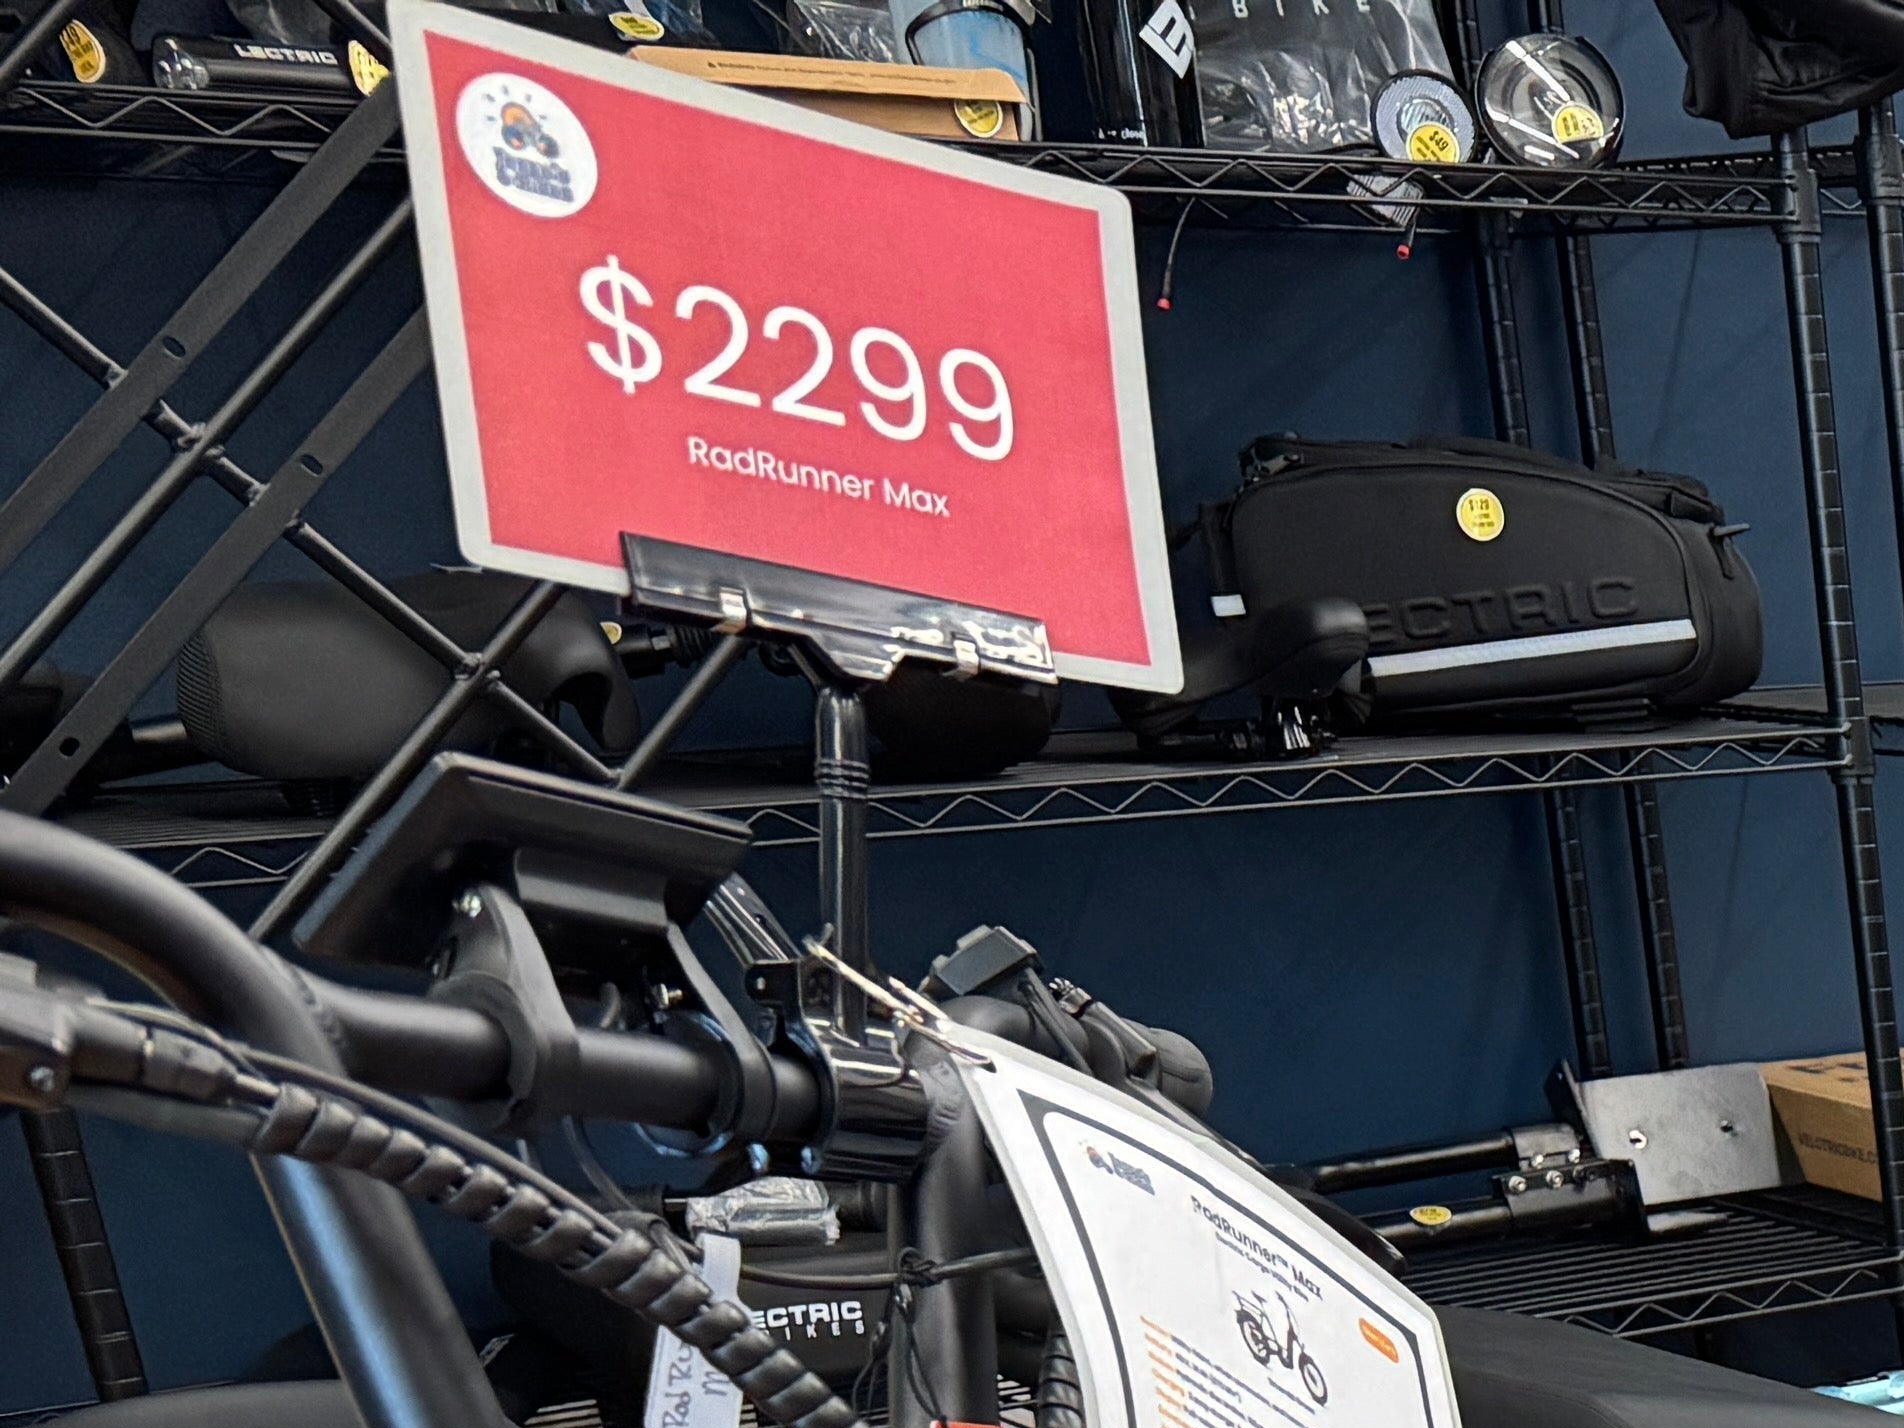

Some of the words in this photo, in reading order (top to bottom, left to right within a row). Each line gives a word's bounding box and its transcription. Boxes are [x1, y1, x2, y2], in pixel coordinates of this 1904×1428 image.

[233, 44, 338, 65] LECTRIC
[577, 254, 1016, 462] $2299
[687, 435, 874, 503] RadRunner
[883, 477, 951, 520] Max
[1364, 578, 1639, 646] ECTRIC
[1292, 1265, 1323, 1300] Max
[756, 1301, 865, 1331] ECTRIC
